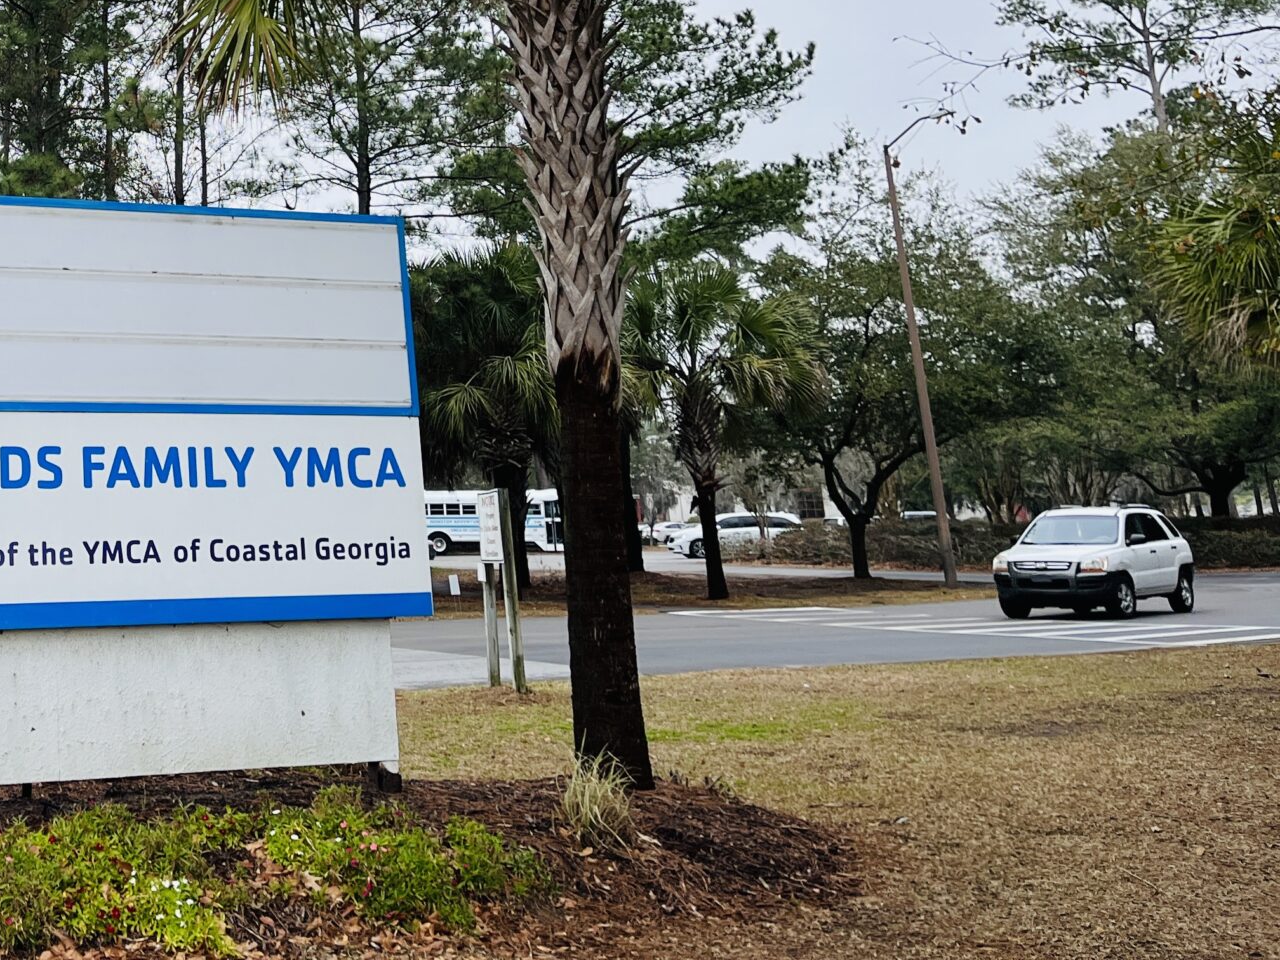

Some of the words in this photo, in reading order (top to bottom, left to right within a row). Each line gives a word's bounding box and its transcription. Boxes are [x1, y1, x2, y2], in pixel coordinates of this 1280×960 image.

[82, 445, 255, 489] FAMILY
[272, 446, 407, 489] YMCA
[27, 540, 73, 567] the
[82, 539, 162, 565] YMCA
[173, 538, 201, 563] of
[209, 537, 306, 563] Coastal
[315, 537, 411, 567] Georgia
